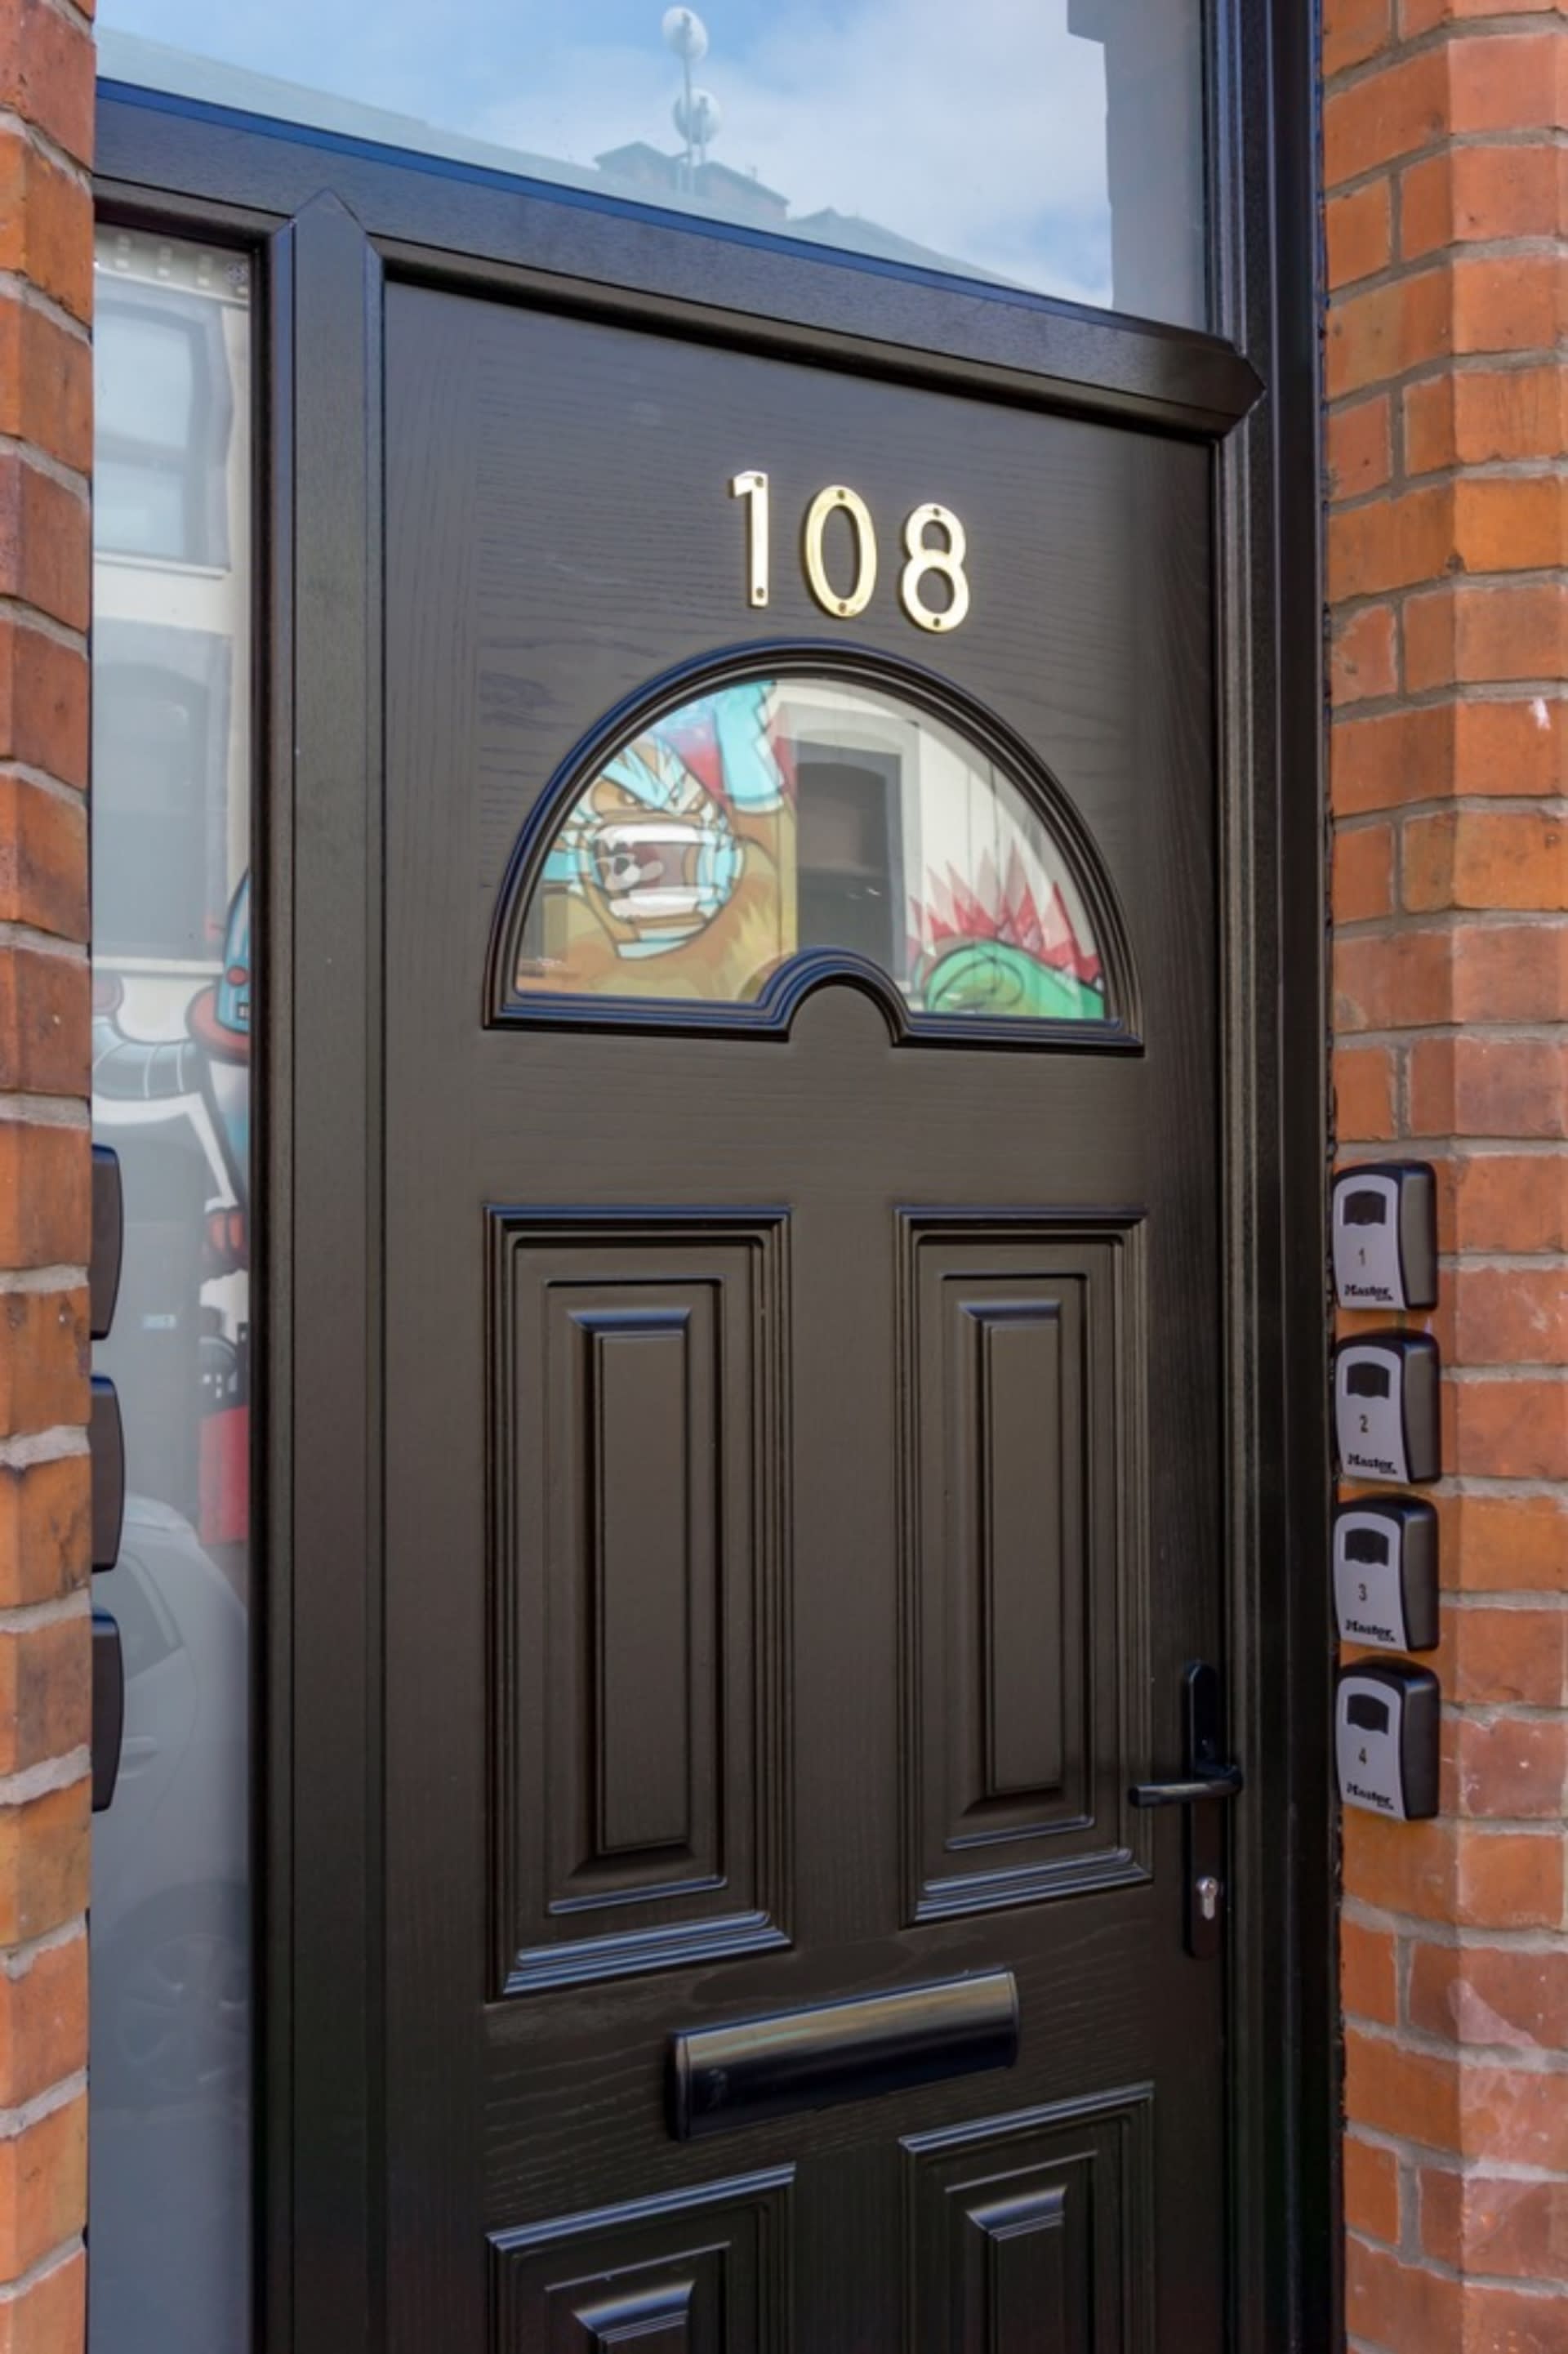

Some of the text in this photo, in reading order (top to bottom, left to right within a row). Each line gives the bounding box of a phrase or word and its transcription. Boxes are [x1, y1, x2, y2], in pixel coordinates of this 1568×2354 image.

[733, 470, 969, 633] 108
[1358, 1247, 1366, 1266] 1
[1359, 1413, 1369, 1433] 2
[1358, 1583, 1367, 1602] 3
[1358, 1746, 1367, 1765] 4
